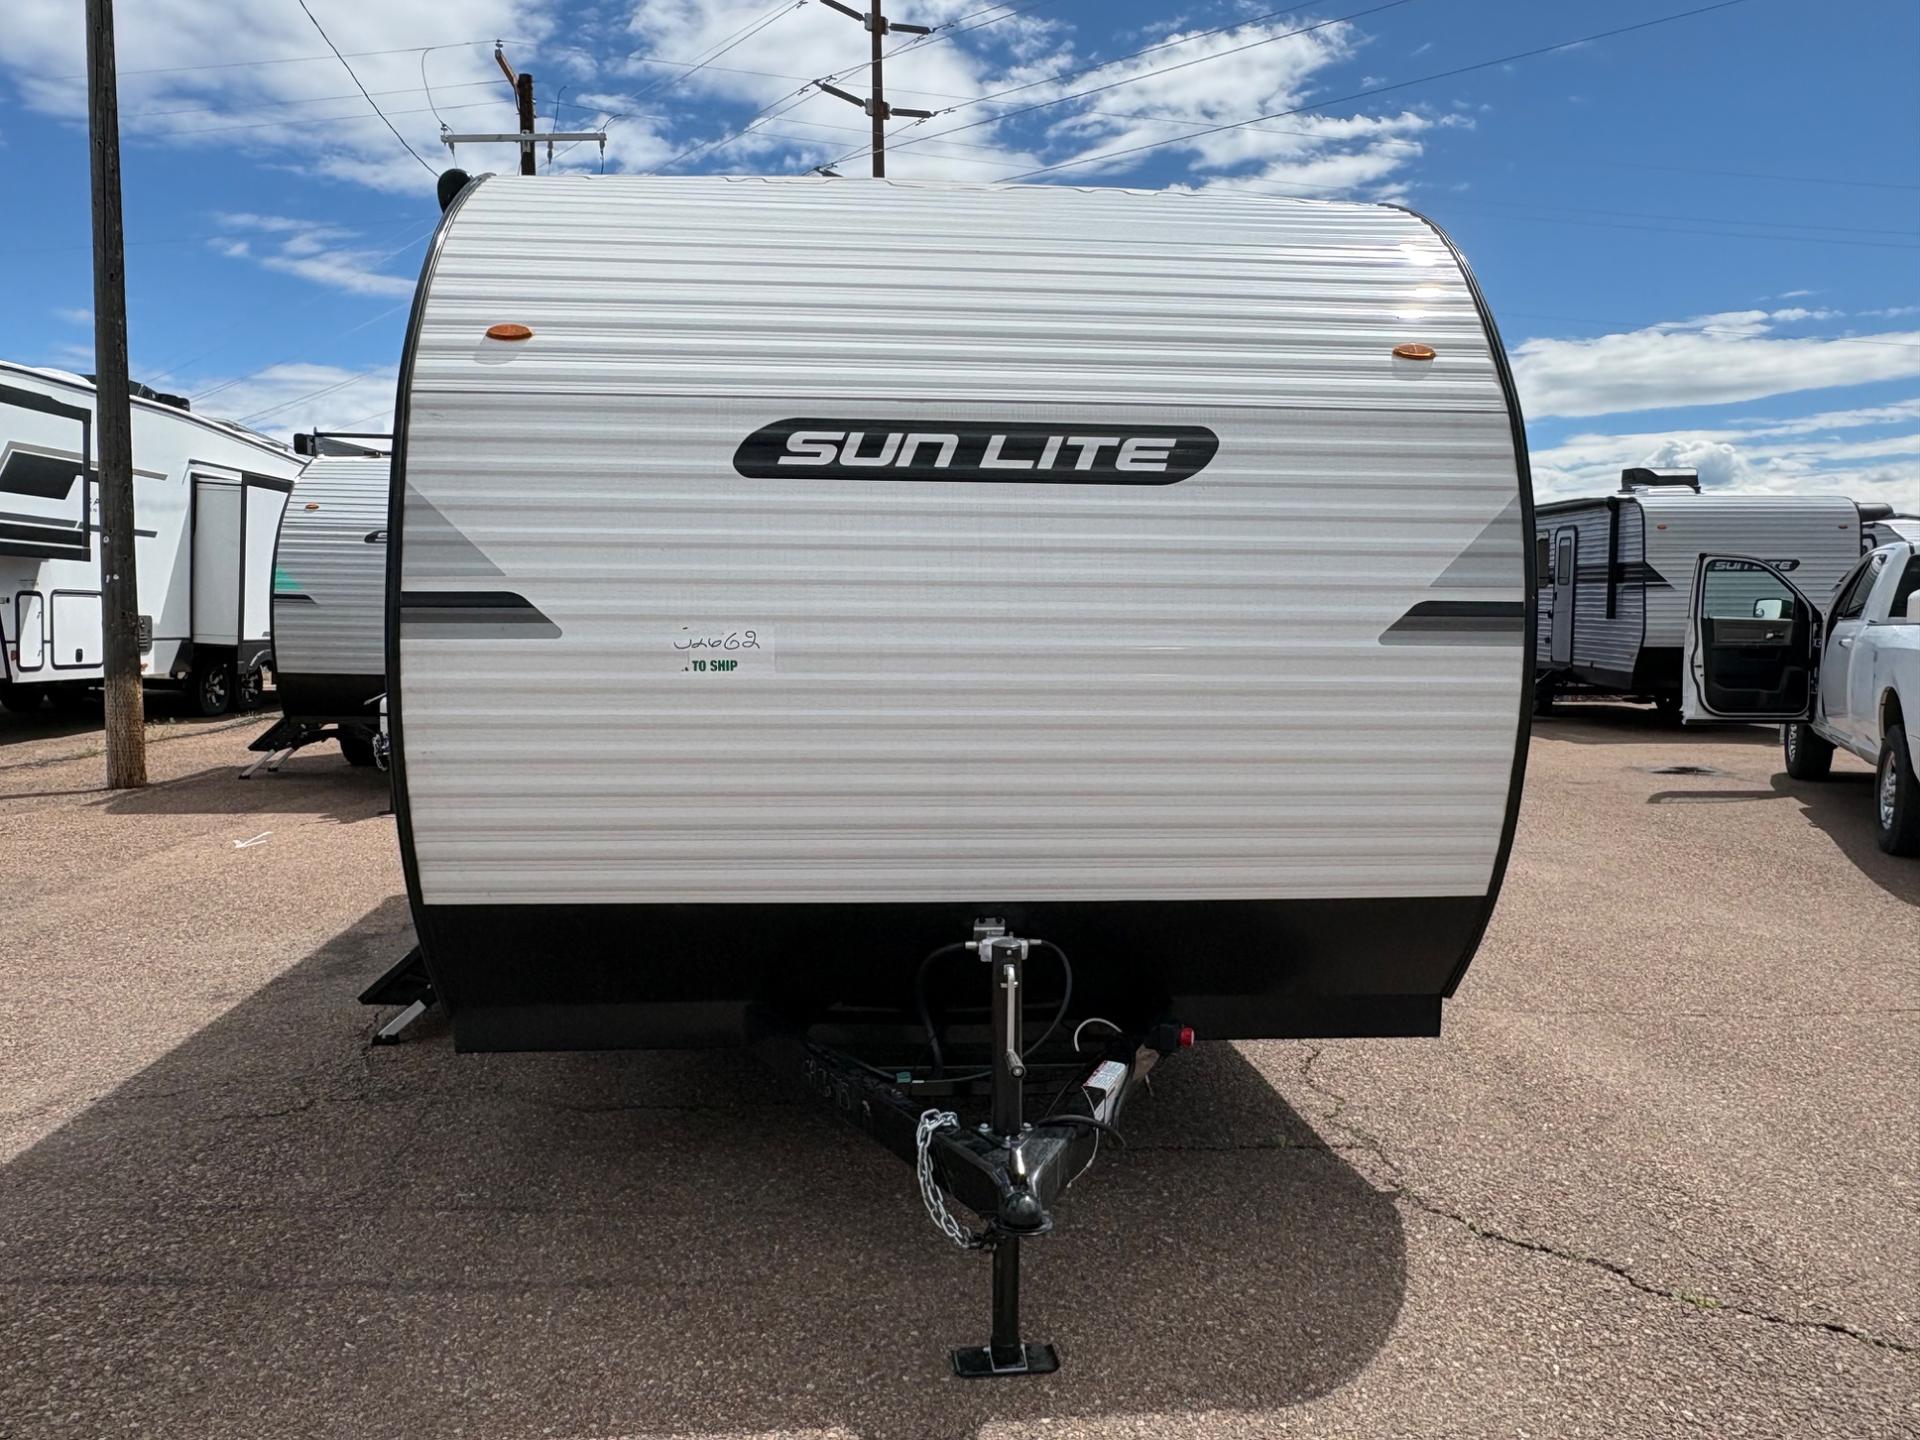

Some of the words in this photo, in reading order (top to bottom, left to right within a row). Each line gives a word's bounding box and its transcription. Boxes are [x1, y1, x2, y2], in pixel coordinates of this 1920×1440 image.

[777, 431, 959, 467] SUN
[979, 435, 1177, 472] LITE
[692, 660, 706, 672] TO
[710, 660, 738, 672] SHIP
